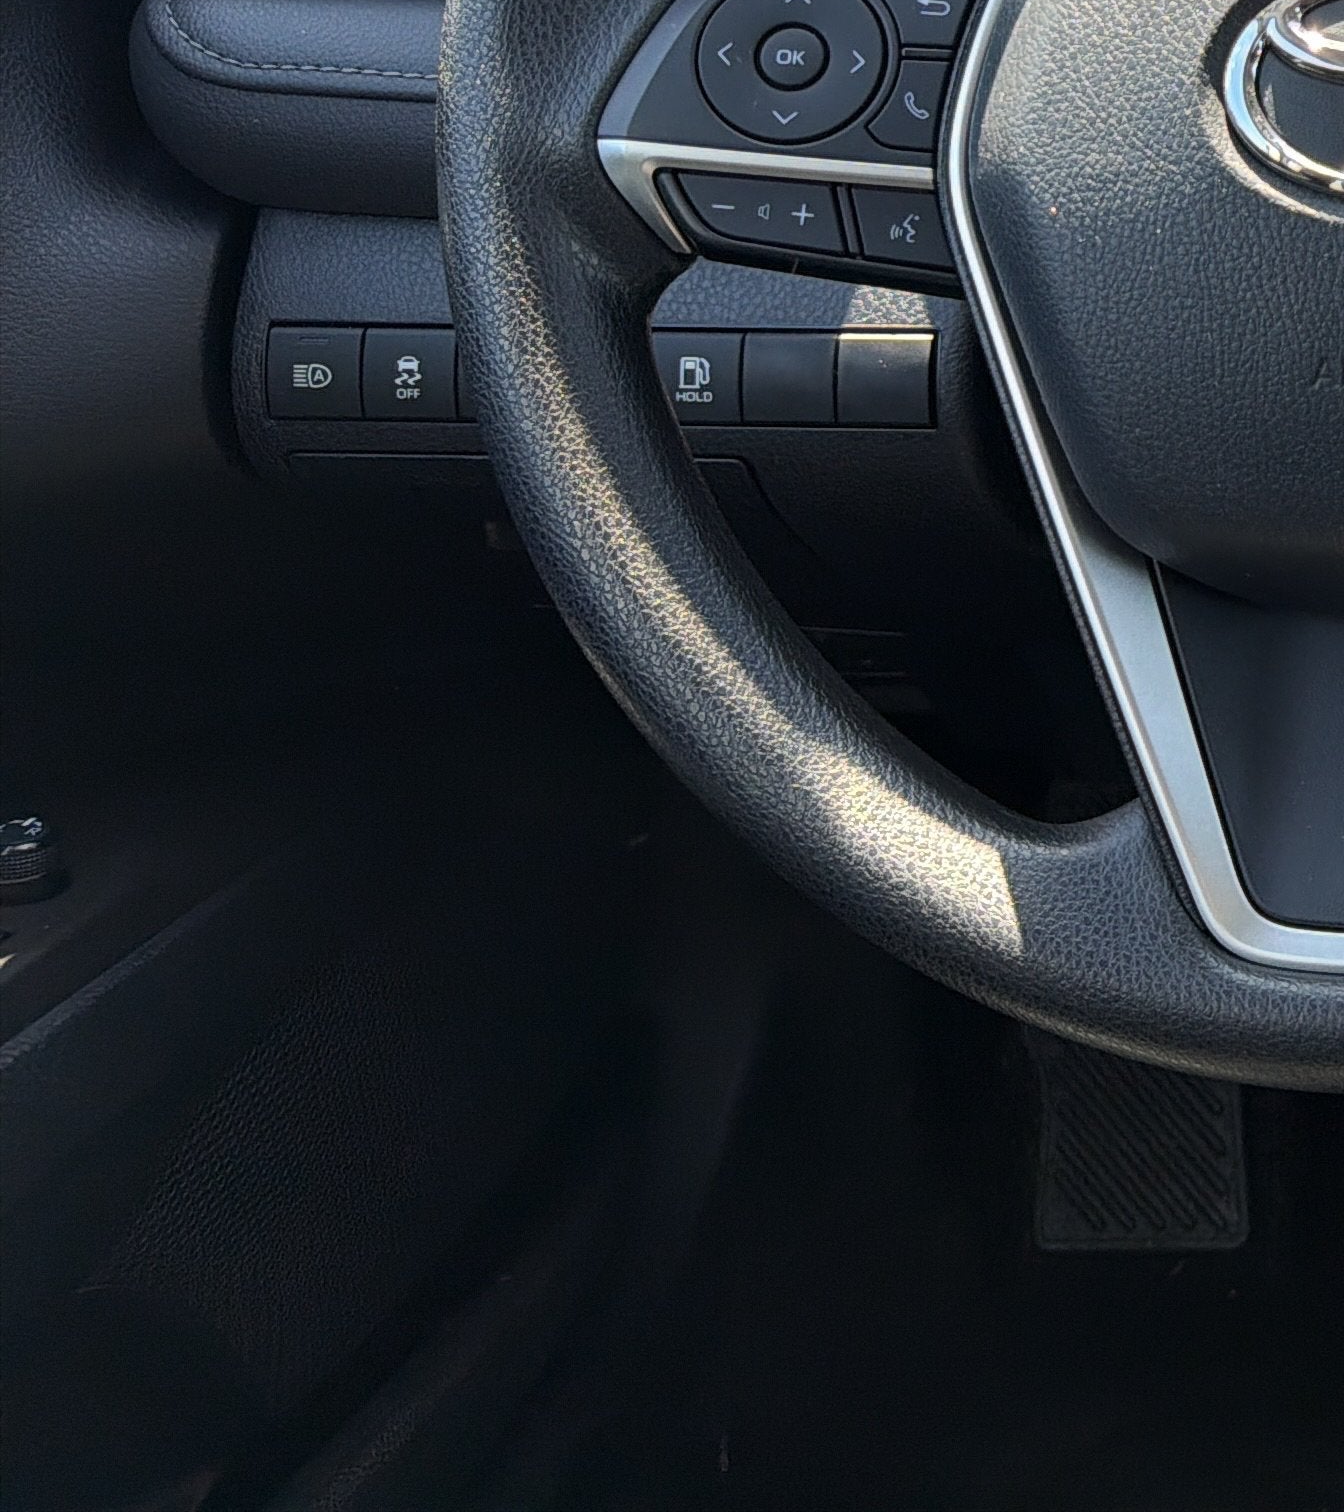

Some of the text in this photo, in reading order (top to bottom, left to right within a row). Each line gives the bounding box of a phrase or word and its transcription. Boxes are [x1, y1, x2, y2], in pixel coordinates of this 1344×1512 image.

[776, 49, 805, 66] OK
[396, 388, 421, 400] OFF
[675, 390, 713, 403] HOLD
